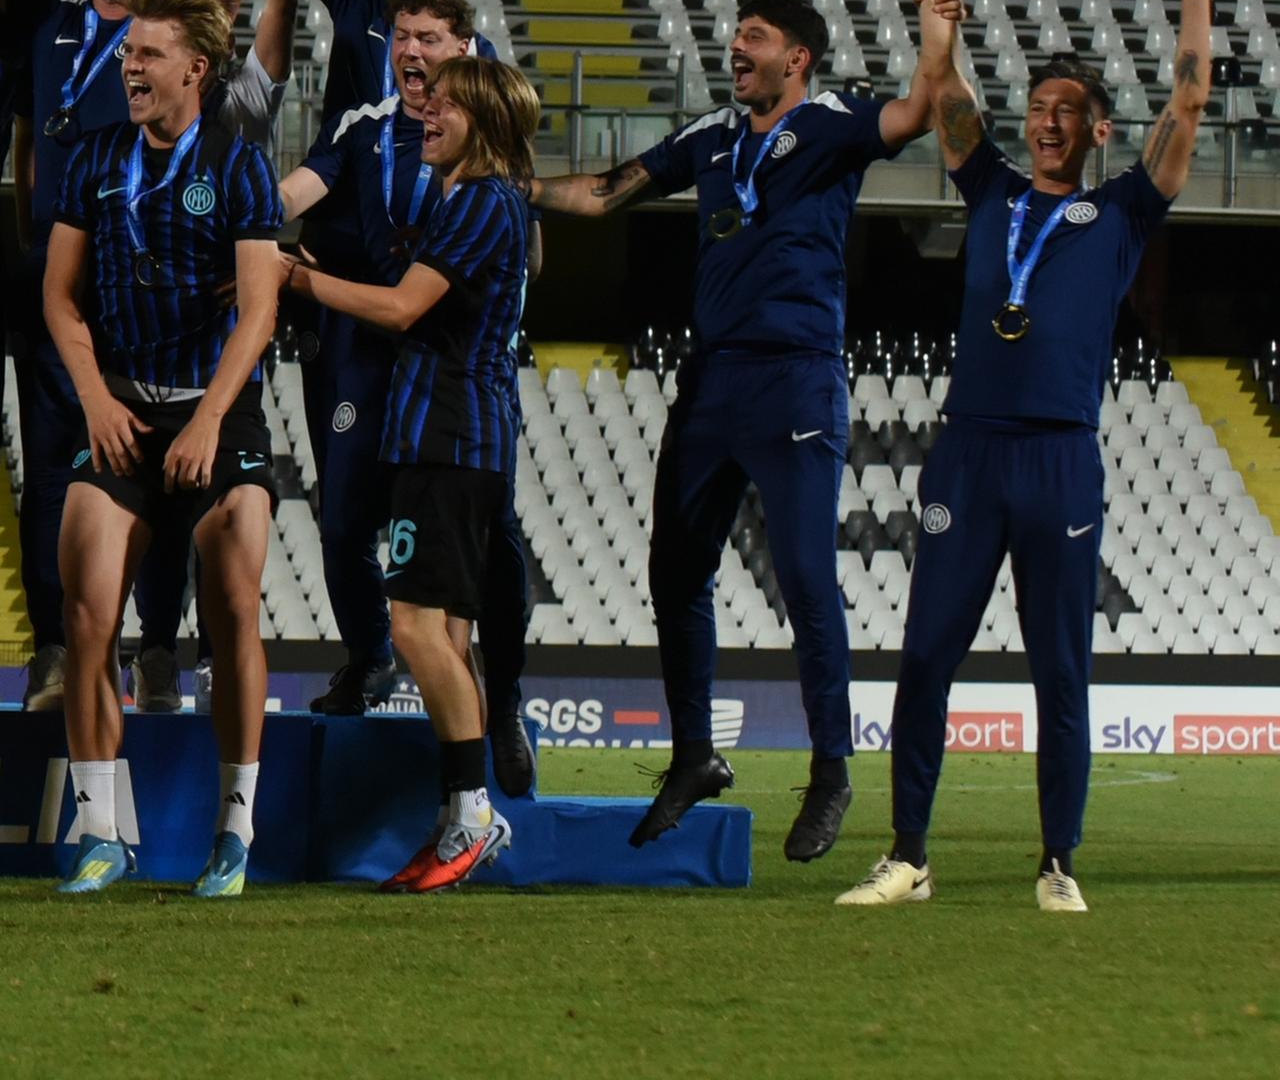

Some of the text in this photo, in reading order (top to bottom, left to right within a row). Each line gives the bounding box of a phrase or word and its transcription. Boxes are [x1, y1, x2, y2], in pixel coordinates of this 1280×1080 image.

[525, 698, 604, 734] SGS
[853, 713, 893, 752] ky
[1103, 715, 1280, 754] sky sport
